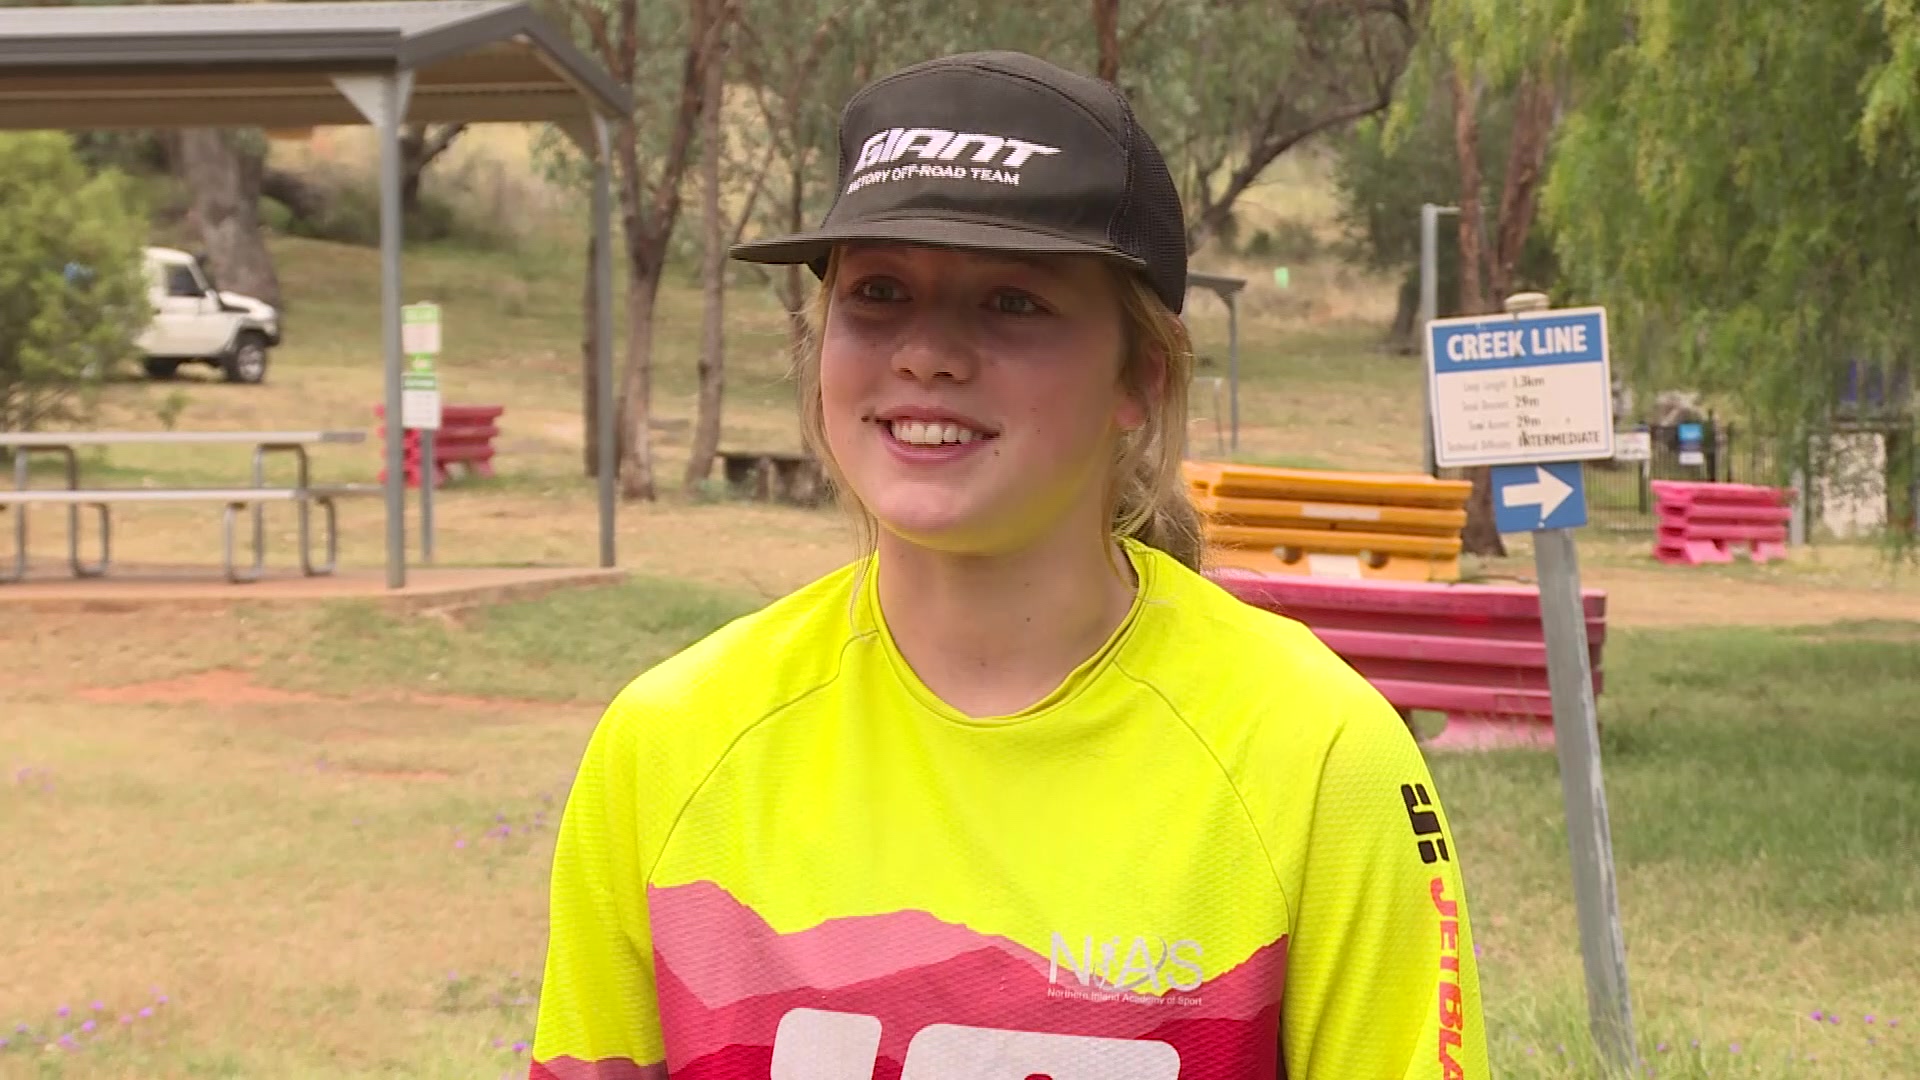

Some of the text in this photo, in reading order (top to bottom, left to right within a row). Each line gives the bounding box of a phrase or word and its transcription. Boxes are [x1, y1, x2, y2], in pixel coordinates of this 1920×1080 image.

[853, 127, 1062, 175] GIANT
[891, 164, 967, 182] OFF-ROAD
[970, 167, 1020, 186] TEAM
[1447, 324, 1588, 362] CREEK LINE
[1514, 395, 1540, 408] 29m
[1516, 415, 1541, 428] 29m
[1518, 431, 1600, 448] INTERMEDIATE
[1047, 987, 1203, 1007] Northern Inland Academy of Sport
